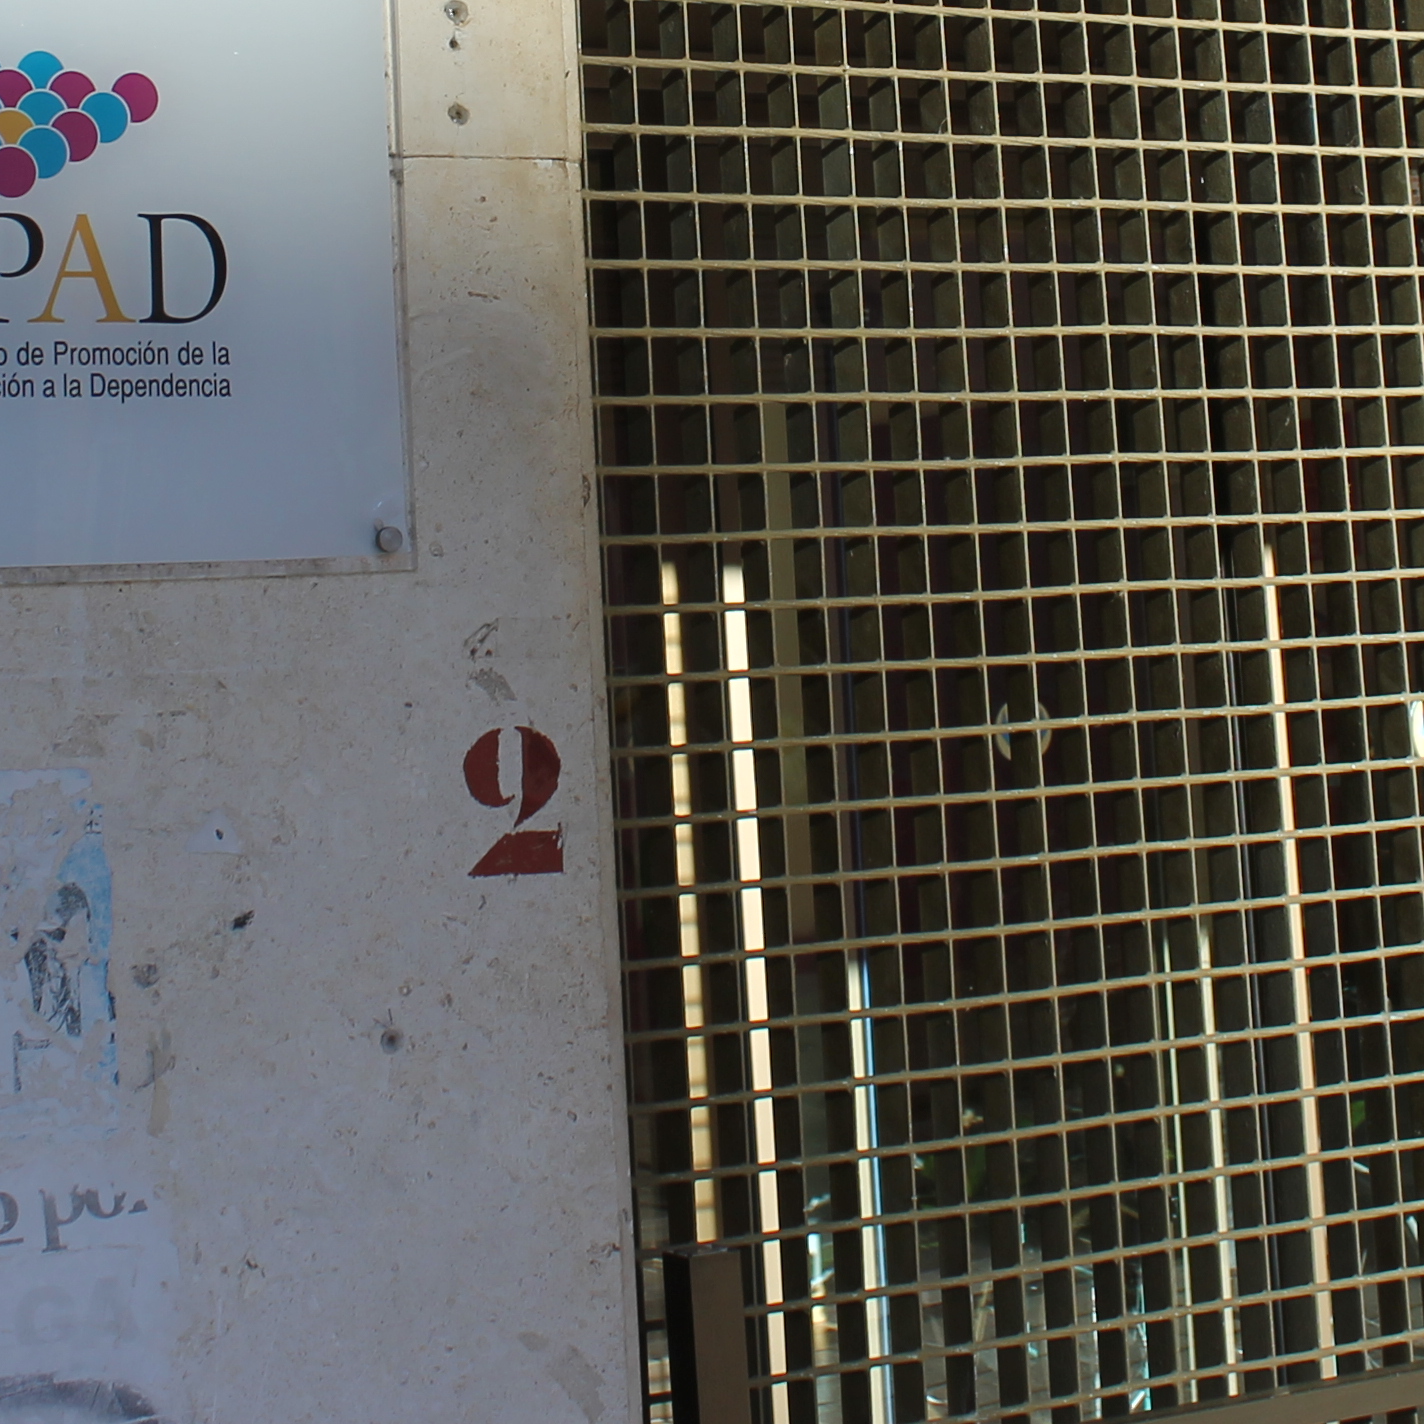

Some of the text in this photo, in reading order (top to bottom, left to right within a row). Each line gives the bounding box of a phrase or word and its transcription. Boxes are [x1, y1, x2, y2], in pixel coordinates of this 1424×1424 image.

[16, 340, 44, 367] de
[53, 340, 169, 367] Promoción
[177, 340, 204, 366] de
[212, 340, 231, 366] la
[42, 378, 56, 398] a
[63, 372, 82, 398] la
[90, 372, 232, 404] Dependencia
[463, 724, 565, 876] 2
